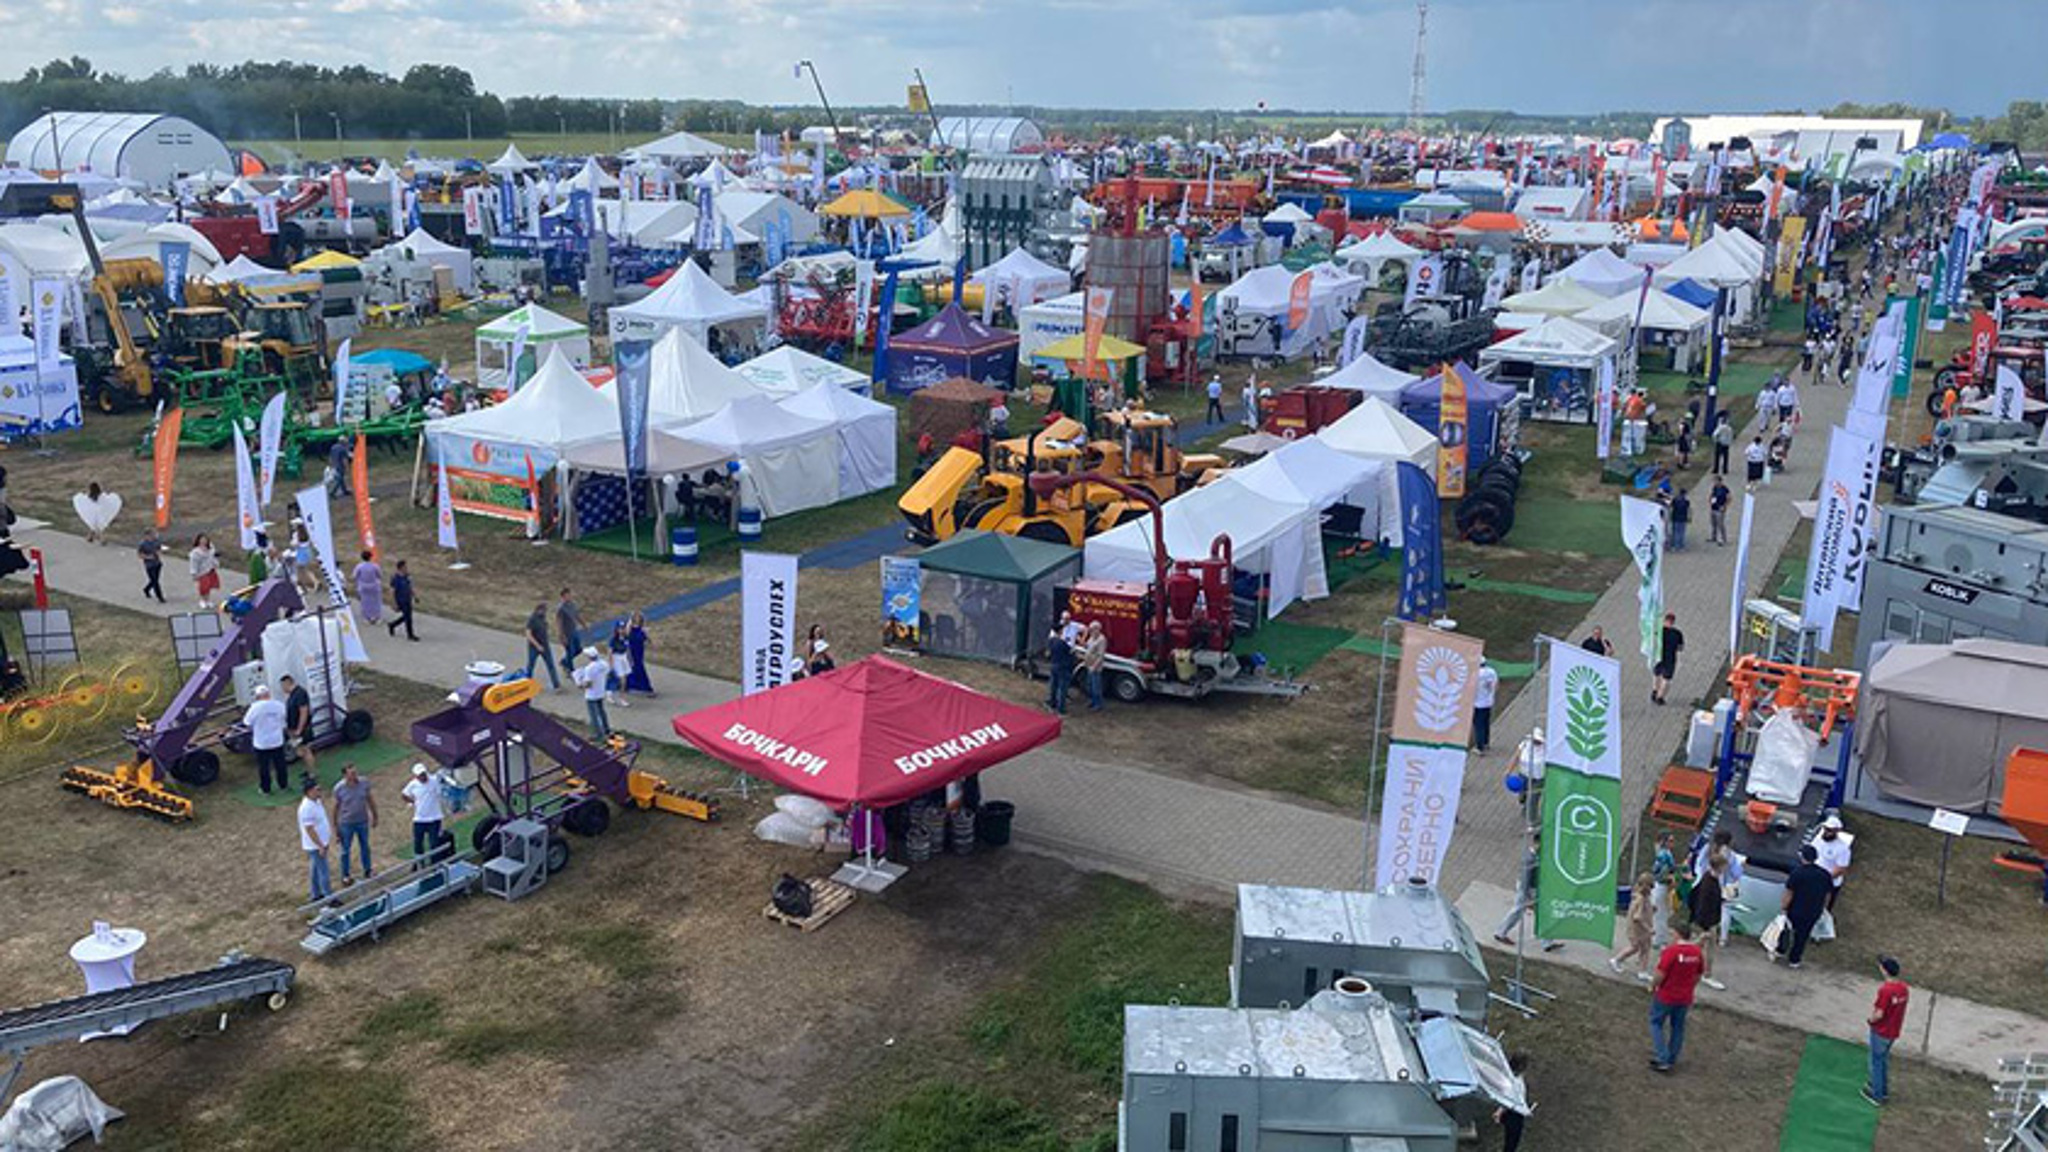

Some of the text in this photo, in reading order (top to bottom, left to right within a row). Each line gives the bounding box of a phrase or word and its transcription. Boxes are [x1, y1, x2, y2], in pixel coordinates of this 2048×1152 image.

[723, 722, 829, 776] БОЧКАРИ
[893, 722, 1009, 775] БОЧКАРИ
[1391, 757, 1425, 885] СОХРАНИ
[1415, 793, 1446, 882] ЗЕРНО
